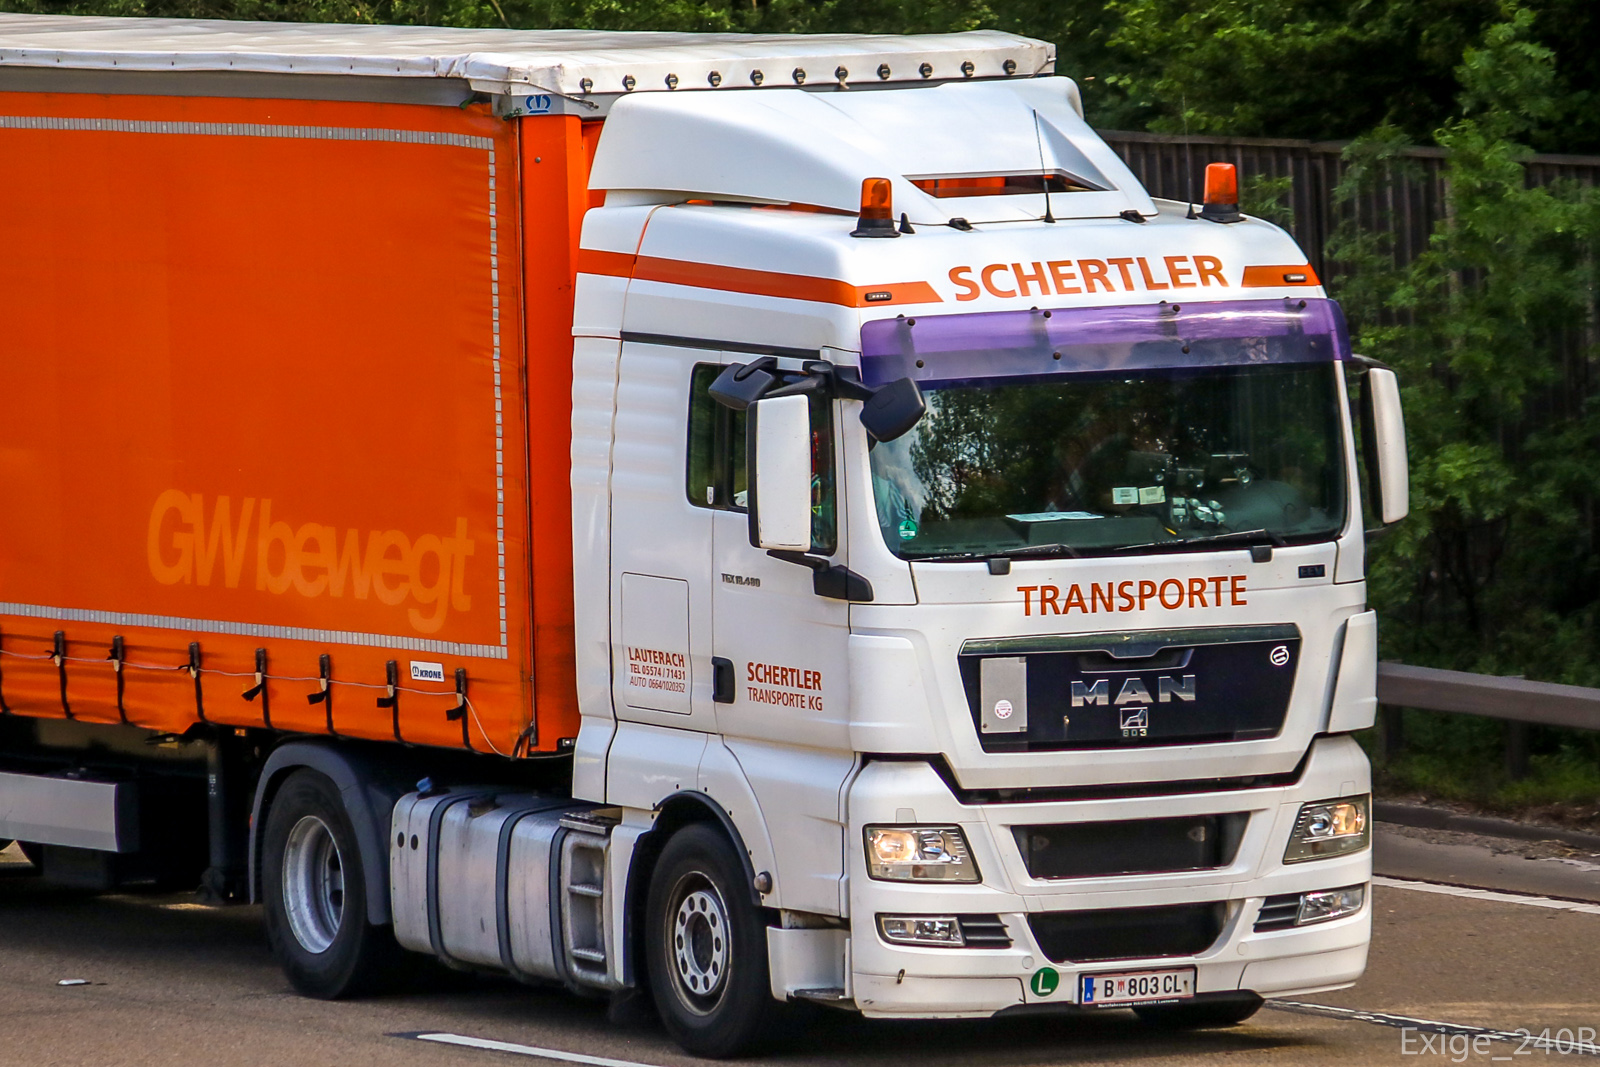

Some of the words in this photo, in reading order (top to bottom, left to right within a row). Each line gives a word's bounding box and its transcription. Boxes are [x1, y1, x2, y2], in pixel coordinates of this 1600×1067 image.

[948, 255, 1230, 302] SCHERTLER
[1017, 575, 1248, 617] TRANSPORTE
[628, 646, 685, 668] LAUTERACH
[420, 669, 442, 679] KRONE
[629, 676, 647, 688] AUTO
[630, 663, 641, 674] TEL
[666, 668, 686, 680] 71431
[747, 662, 822, 691] SCHERTLER
[747, 687, 806, 709] TRANSPORTE
[808, 696, 823, 711] KG
[1071, 674, 1196, 707] MAN
[1122, 728, 1148, 737] 803
[1038, 972, 1052, 993] L
[1104, 980, 1114, 997] B
[1128, 976, 1159, 996] 803
[1163, 974, 1182, 993] CL
